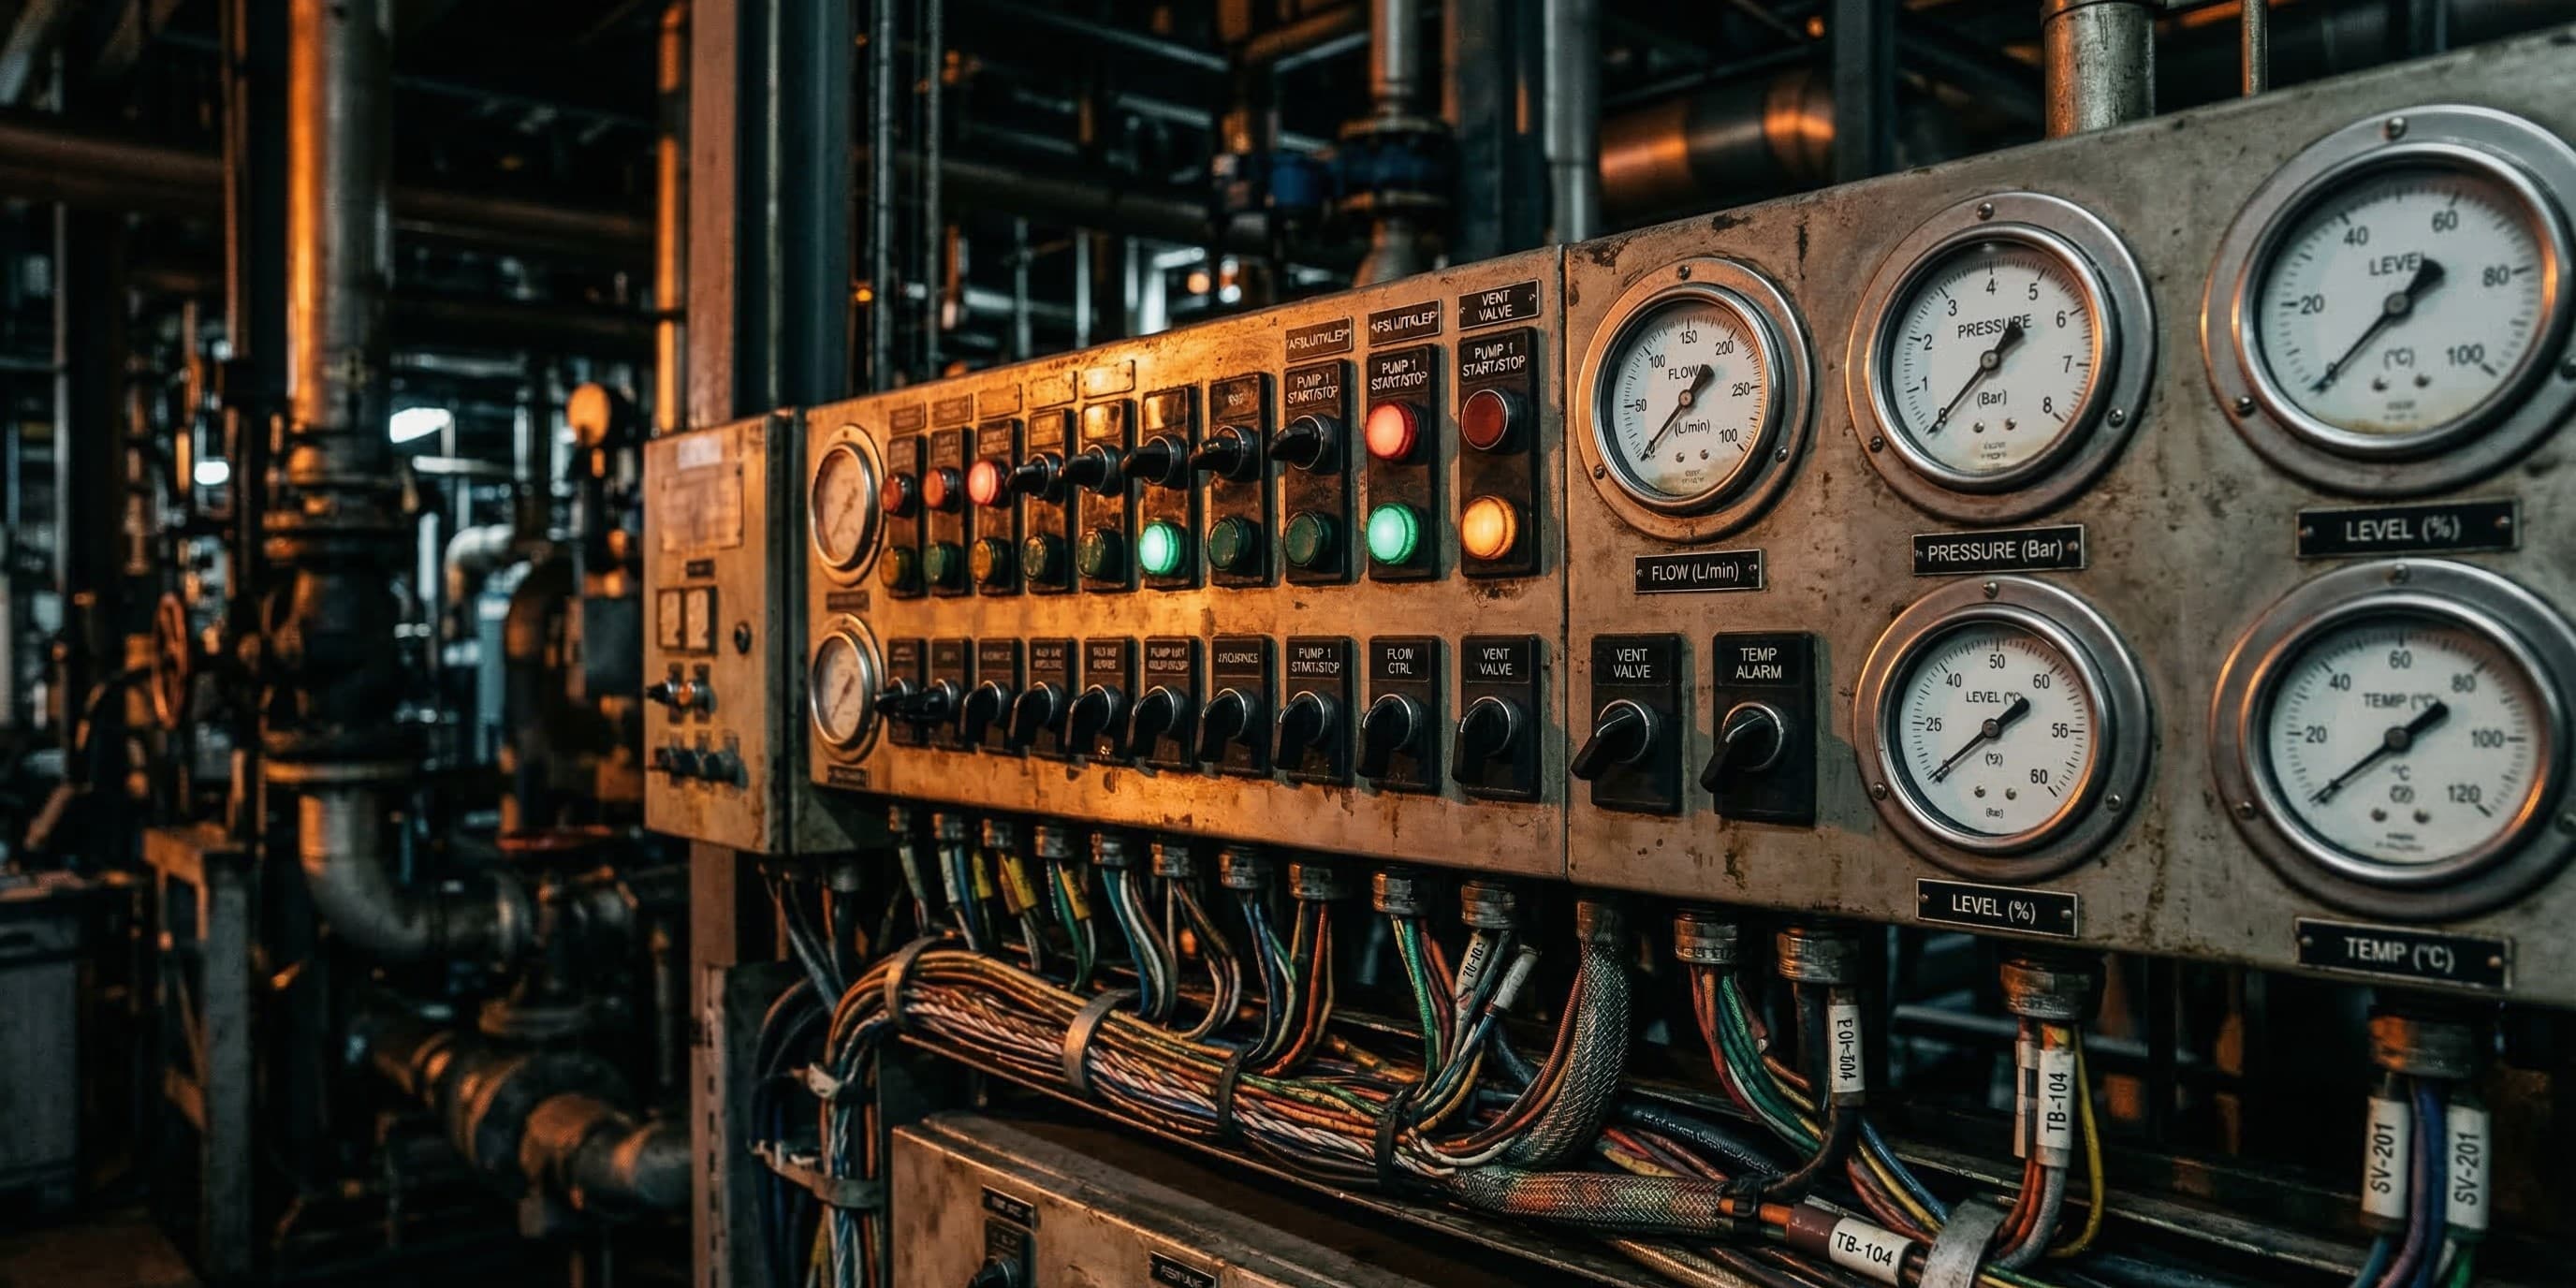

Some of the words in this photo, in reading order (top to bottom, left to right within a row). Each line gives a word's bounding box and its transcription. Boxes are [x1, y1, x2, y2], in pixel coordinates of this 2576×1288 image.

[2432, 210, 2459, 233] 60
[2343, 226, 2369, 246] 40
[2482, 265, 2510, 287] 80
[1985, 279, 1997, 296] 4
[2028, 283, 2039, 301] 5
[1481, 289, 1511, 305] VENT
[2300, 295, 2325, 315] 20
[1478, 304, 1514, 322] VALVE
[1948, 300, 1958, 317] 3
[1957, 313, 2032, 339] PRESSURE
[2056, 311, 2067, 329] 6
[1679, 329, 1698, 345] 150
[1924, 334, 1933, 351] 2
[1474, 344, 1503, 359] PUMP
[1508, 342, 1514, 355] 1
[1715, 341, 1734, 357] 200
[2446, 344, 2485, 366] 100
[1412, 359, 1416, 372] 1
[1462, 354, 1526, 378] START/STOP
[1648, 354, 1666, 370] 100
[2063, 356, 2073, 373] 7
[1667, 363, 1699, 381] FLOW
[1731, 382, 1750, 398] 250
[1921, 375, 1928, 391] 1
[1976, 388, 2008, 407] (Bar)
[2042, 397, 2053, 415] 8
[1719, 428, 1738, 445] 100
[2345, 519, 2414, 542] LEVEL
[2421, 516, 2462, 542] (%)
[1927, 539, 2016, 563] PRESSURE
[2021, 536, 2064, 562] (Bar)
[1651, 564, 1689, 582] FLOW
[1691, 561, 1740, 582] (L/min)
[1387, 648, 1414, 660] FLOW
[1483, 648, 1511, 660] VENT
[1617, 648, 1648, 662] VENT
[1740, 647, 1778, 662] TEMP
[1989, 654, 2006, 670] 50
[2389, 651, 2412, 669] 60
[1388, 663, 1412, 675] CTRL
[1479, 663, 1514, 676] VALVE
[1613, 665, 1652, 679] VALVE
[1735, 665, 1782, 680] ALARM
[1945, 673, 1962, 688] 40
[2033, 674, 2050, 689] 60
[2329, 673, 2352, 692] 40
[2452, 674, 2477, 693] 80
[1966, 691, 2001, 704] LEVEL
[2364, 692, 2408, 709] TEMP
[2305, 726, 2328, 744] 20
[2472, 729, 2504, 748] 100
[2030, 768, 2048, 784] 60
[2447, 783, 2482, 803] 120
[1952, 893, 2003, 918] LEVEL
[2008, 900, 2037, 924] (%)
[2344, 937, 2408, 962] TEMP
[2412, 943, 2455, 973] (°C)
[2046, 1072, 2068, 1134] TB-104
[2370, 1122, 2397, 1194] SV-201
[2453, 1132, 2481, 1207] SV-201
[1837, 1231, 1894, 1266] TB-104
